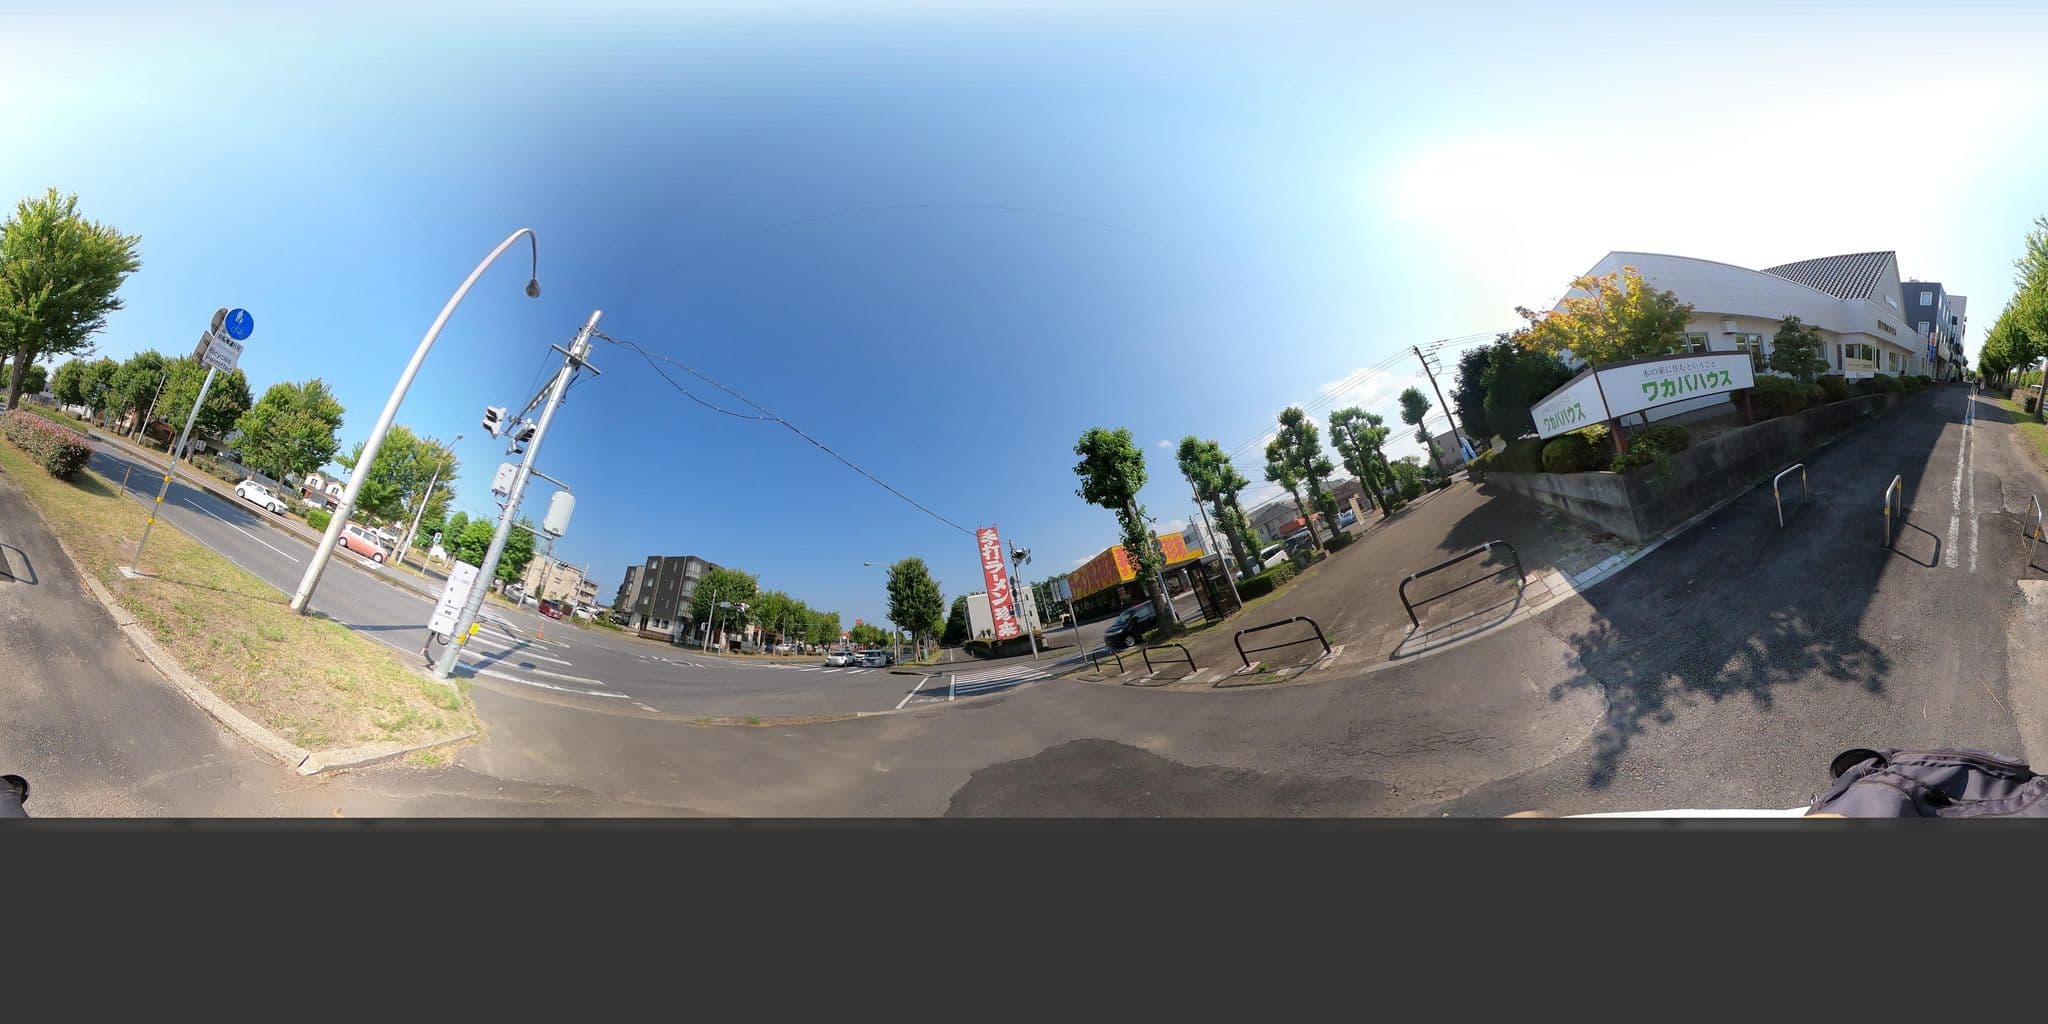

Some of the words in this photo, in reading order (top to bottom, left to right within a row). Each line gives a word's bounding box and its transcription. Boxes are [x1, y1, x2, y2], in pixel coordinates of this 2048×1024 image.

[205, 354, 232, 373] Permitted
[208, 347, 232, 365] Bicycles
[1643, 360, 1717, 378] 木の家に住むということ
[1641, 369, 1733, 402] ワカバハウス
[1543, 402, 1586, 432] ワカバハウス
